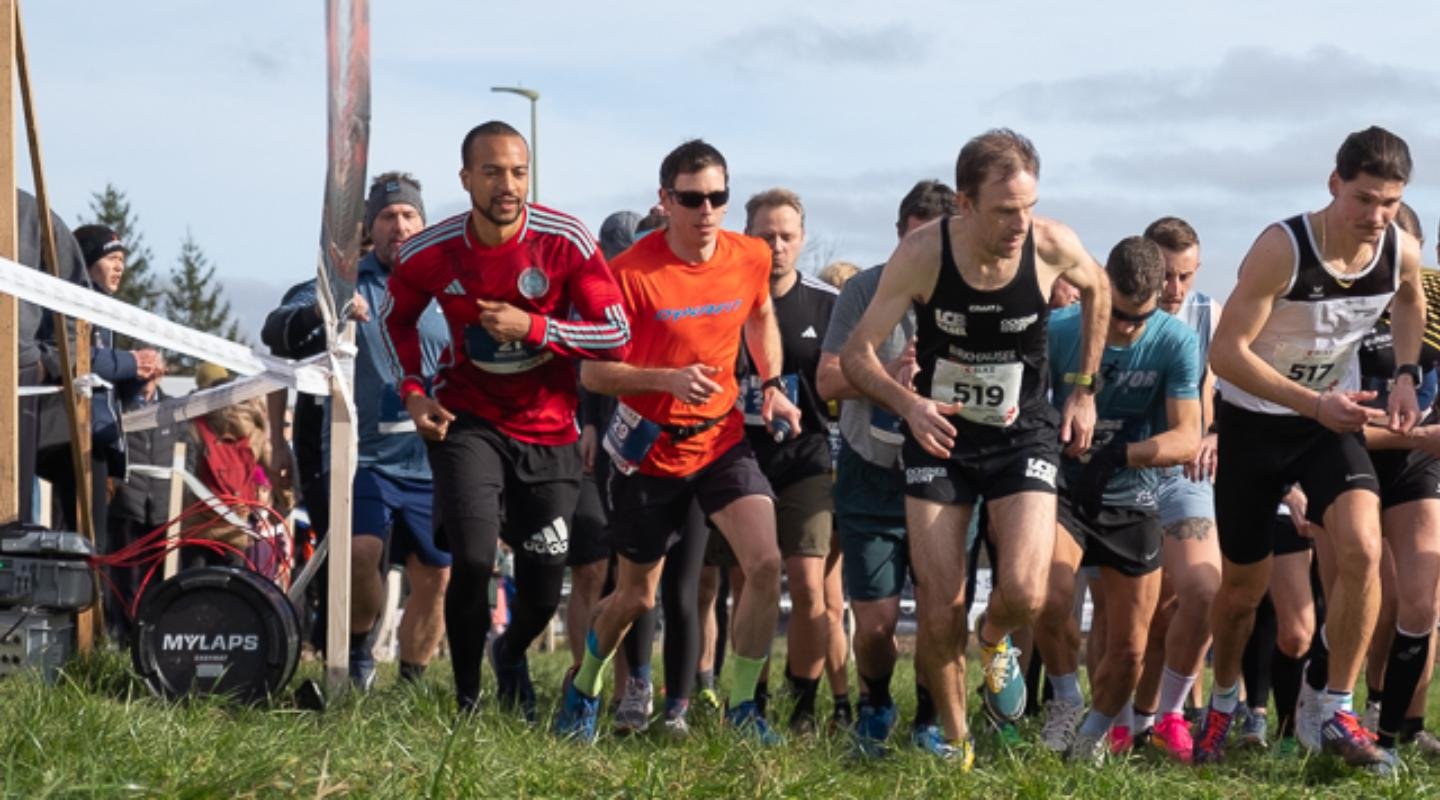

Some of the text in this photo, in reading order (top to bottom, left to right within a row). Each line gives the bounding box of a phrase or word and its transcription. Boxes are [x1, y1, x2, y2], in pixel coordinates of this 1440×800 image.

[1287, 363, 1335, 382] 517
[953, 382, 1005, 408] 519
[162, 633, 259, 651] MYLAPS
